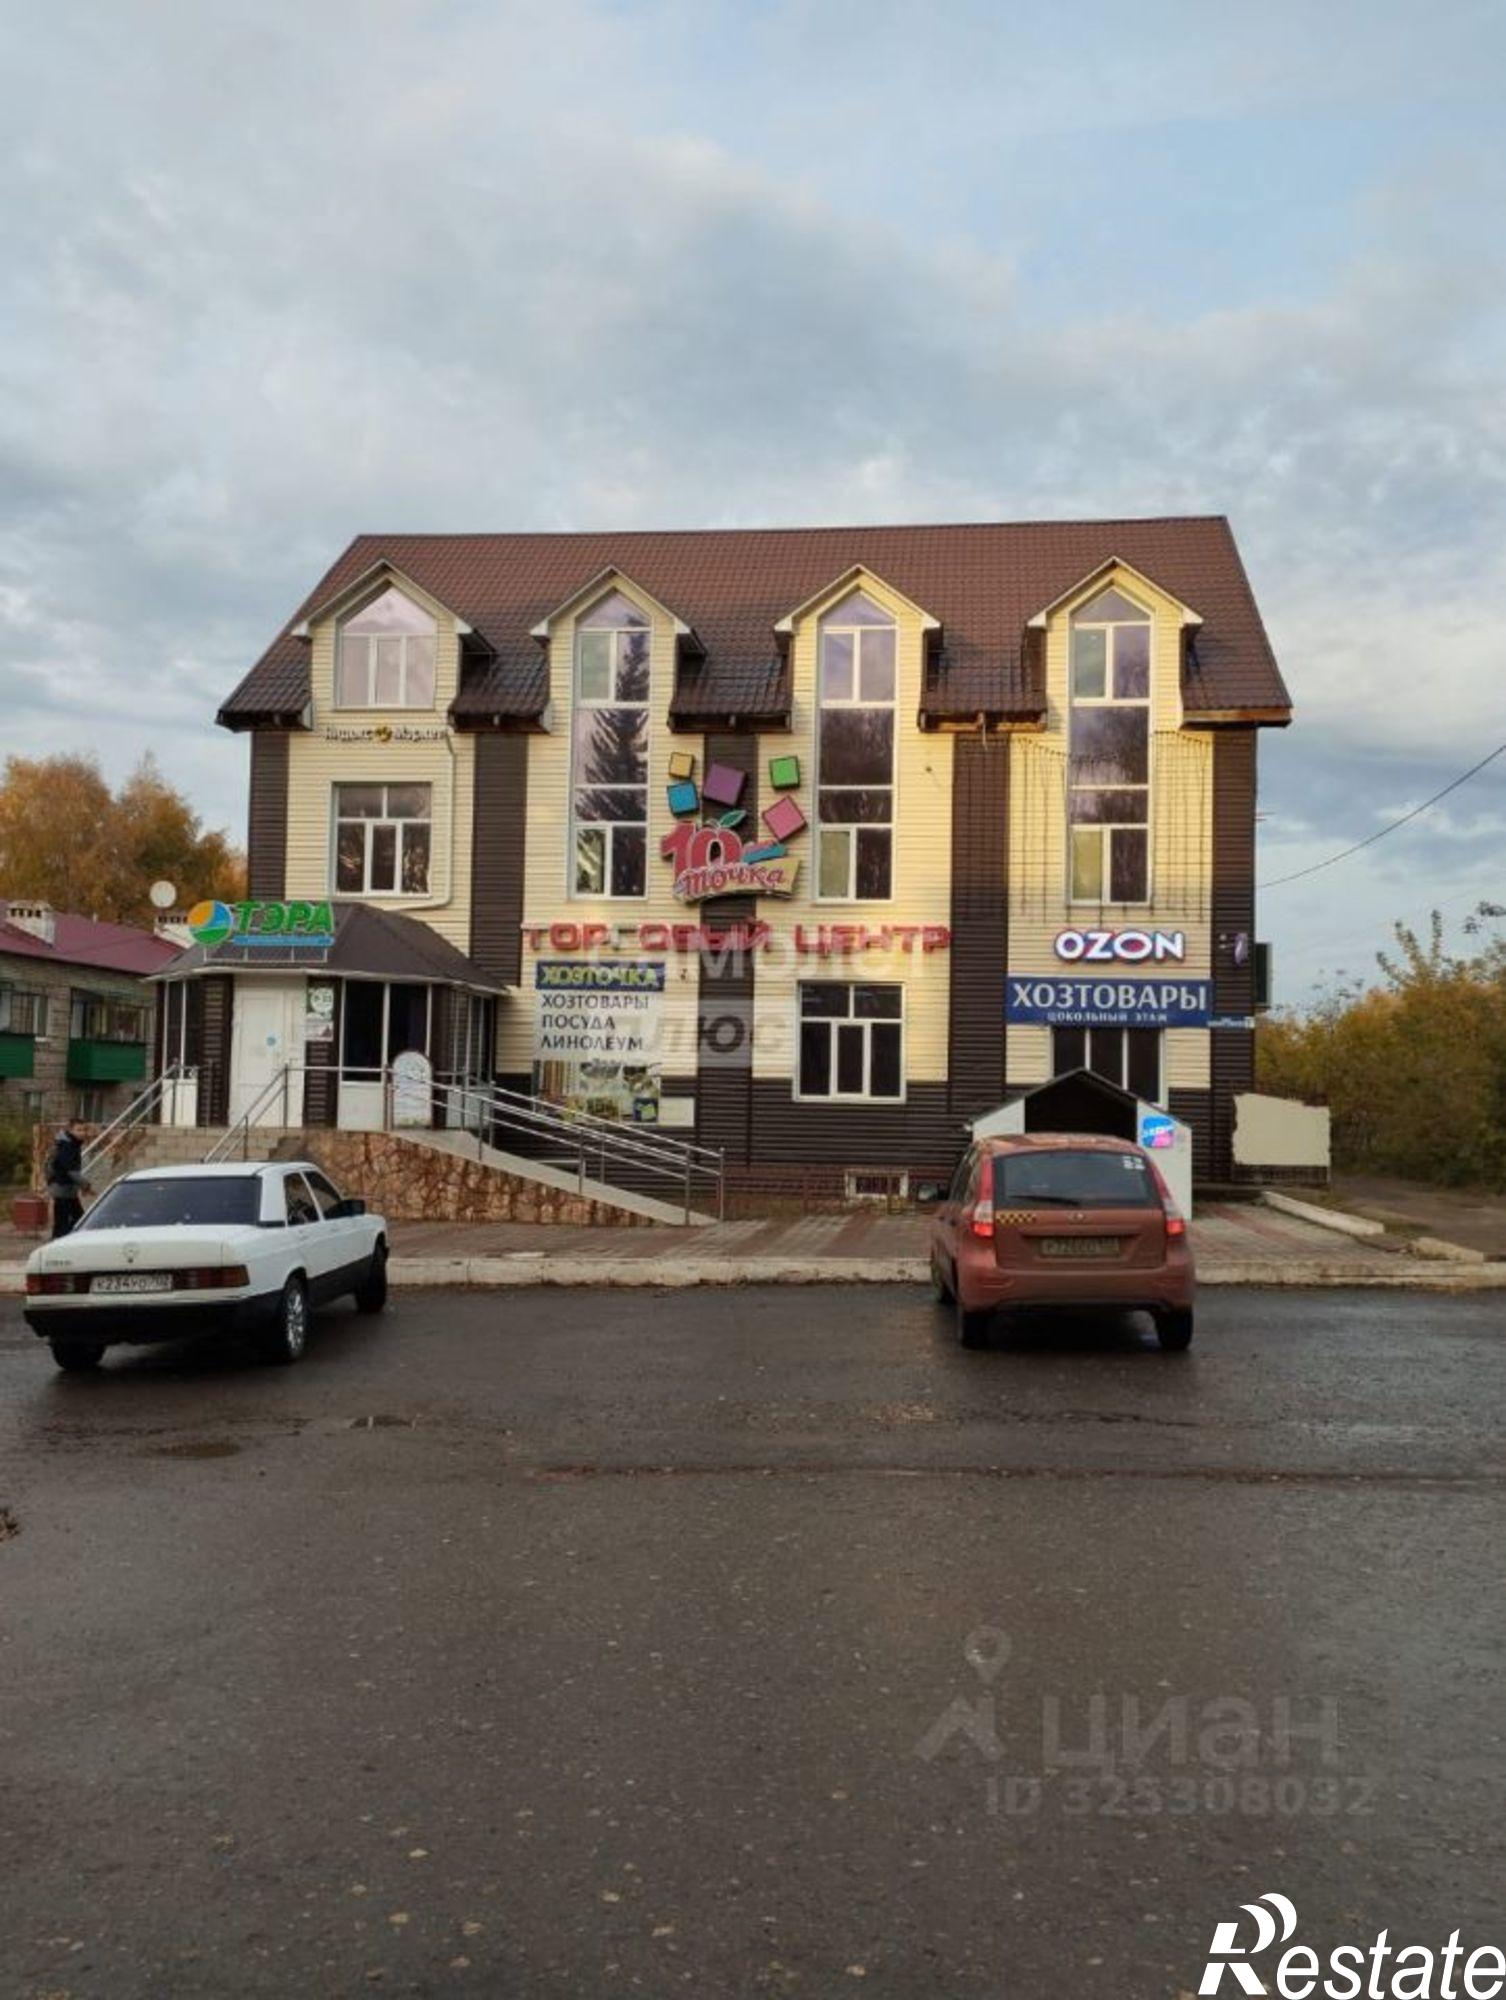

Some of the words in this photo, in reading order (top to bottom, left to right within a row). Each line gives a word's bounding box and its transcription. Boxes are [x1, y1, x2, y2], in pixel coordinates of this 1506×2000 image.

[660, 819, 744, 880] 10
[235, 901, 335, 934] ТЭРА
[1054, 930, 1187, 962] OZON
[541, 994, 649, 1010] ХОЗТОВАРЫ
[1012, 983, 1207, 1010] ХОЗТОВАРЫ
[541, 1014, 616, 1030] ПОСУДА
[1047, 1011, 1129, 1022] ЦОКОЛЬНЫЙ
[1134, 1012, 1169, 1022] ЭТАЖ
[540, 1034, 644, 1051] ЛИНОЛЕУМ
